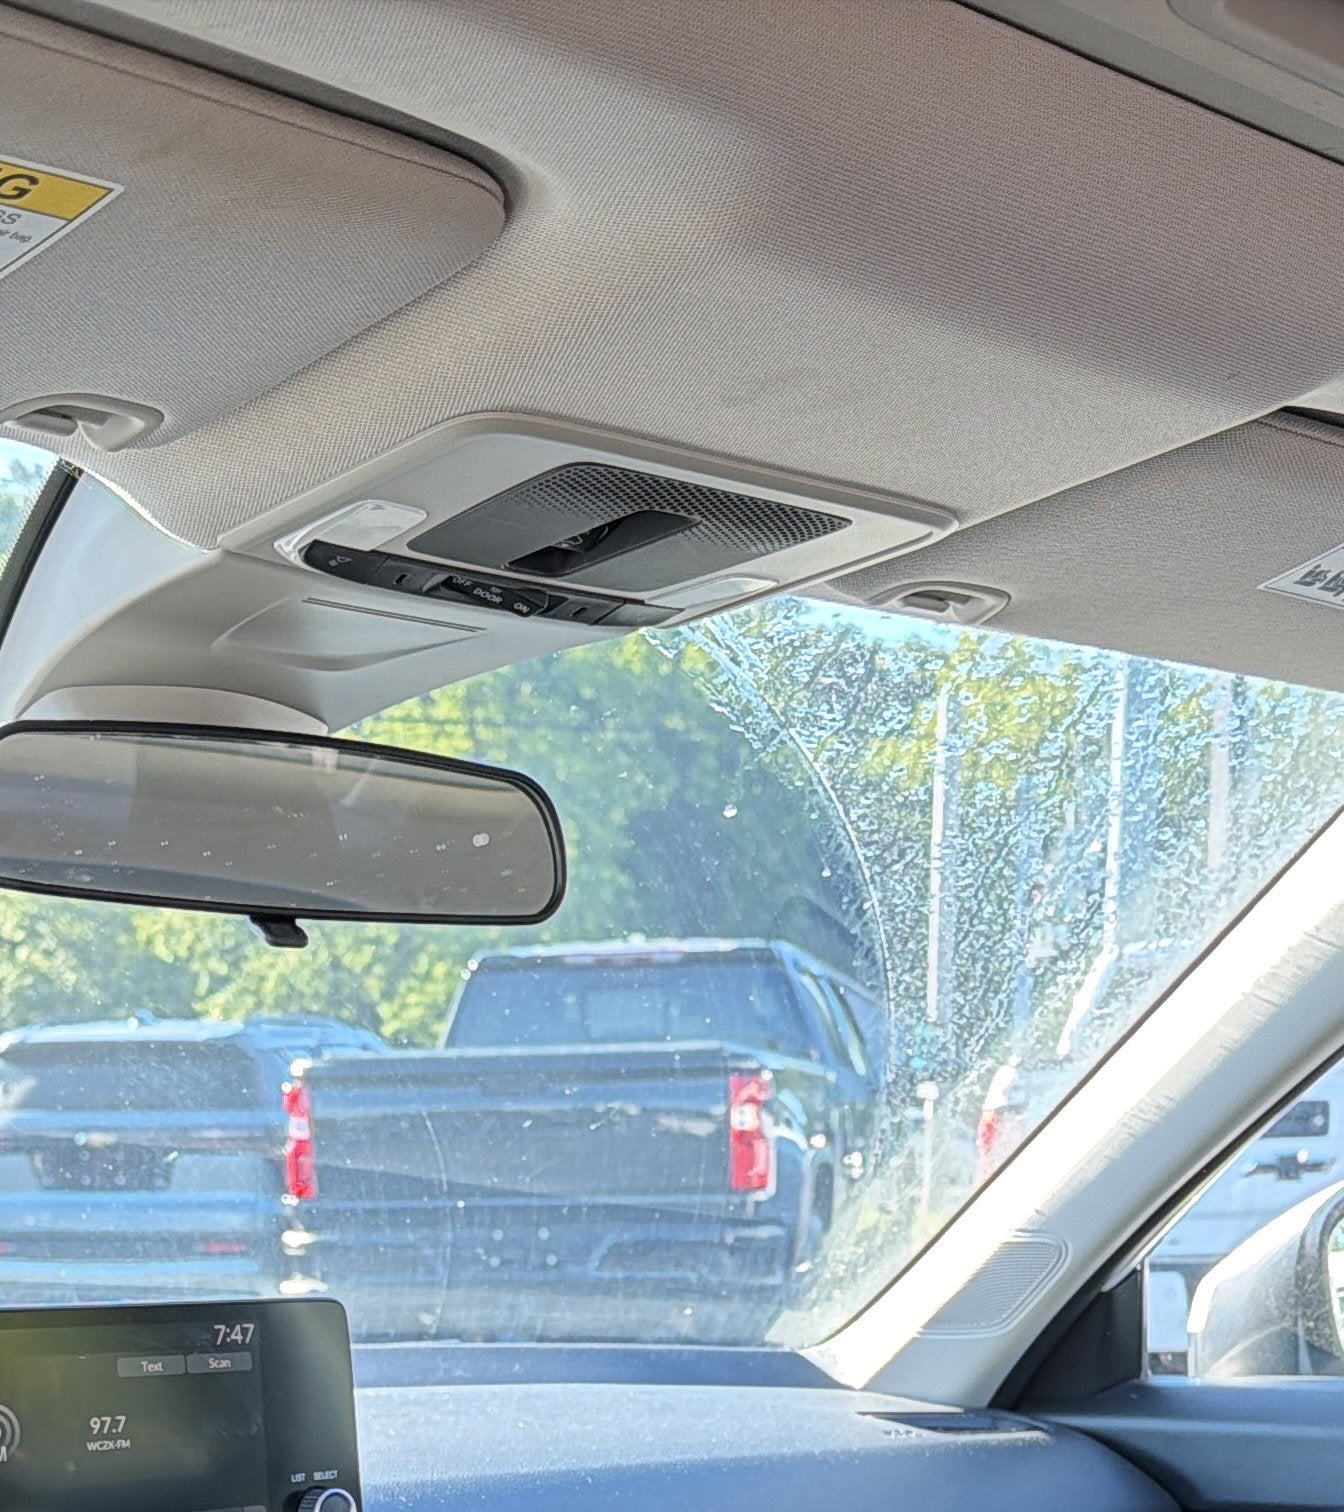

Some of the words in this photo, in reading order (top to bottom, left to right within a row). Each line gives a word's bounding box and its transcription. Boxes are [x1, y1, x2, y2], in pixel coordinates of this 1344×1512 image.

[473, 587, 503, 604] DOOR
[513, 602, 531, 613] ON
[214, 1323, 255, 1346] 7:47
[140, 1361, 164, 1373] Text
[208, 1357, 231, 1369] Scan
[89, 1415, 127, 1435] 97.7
